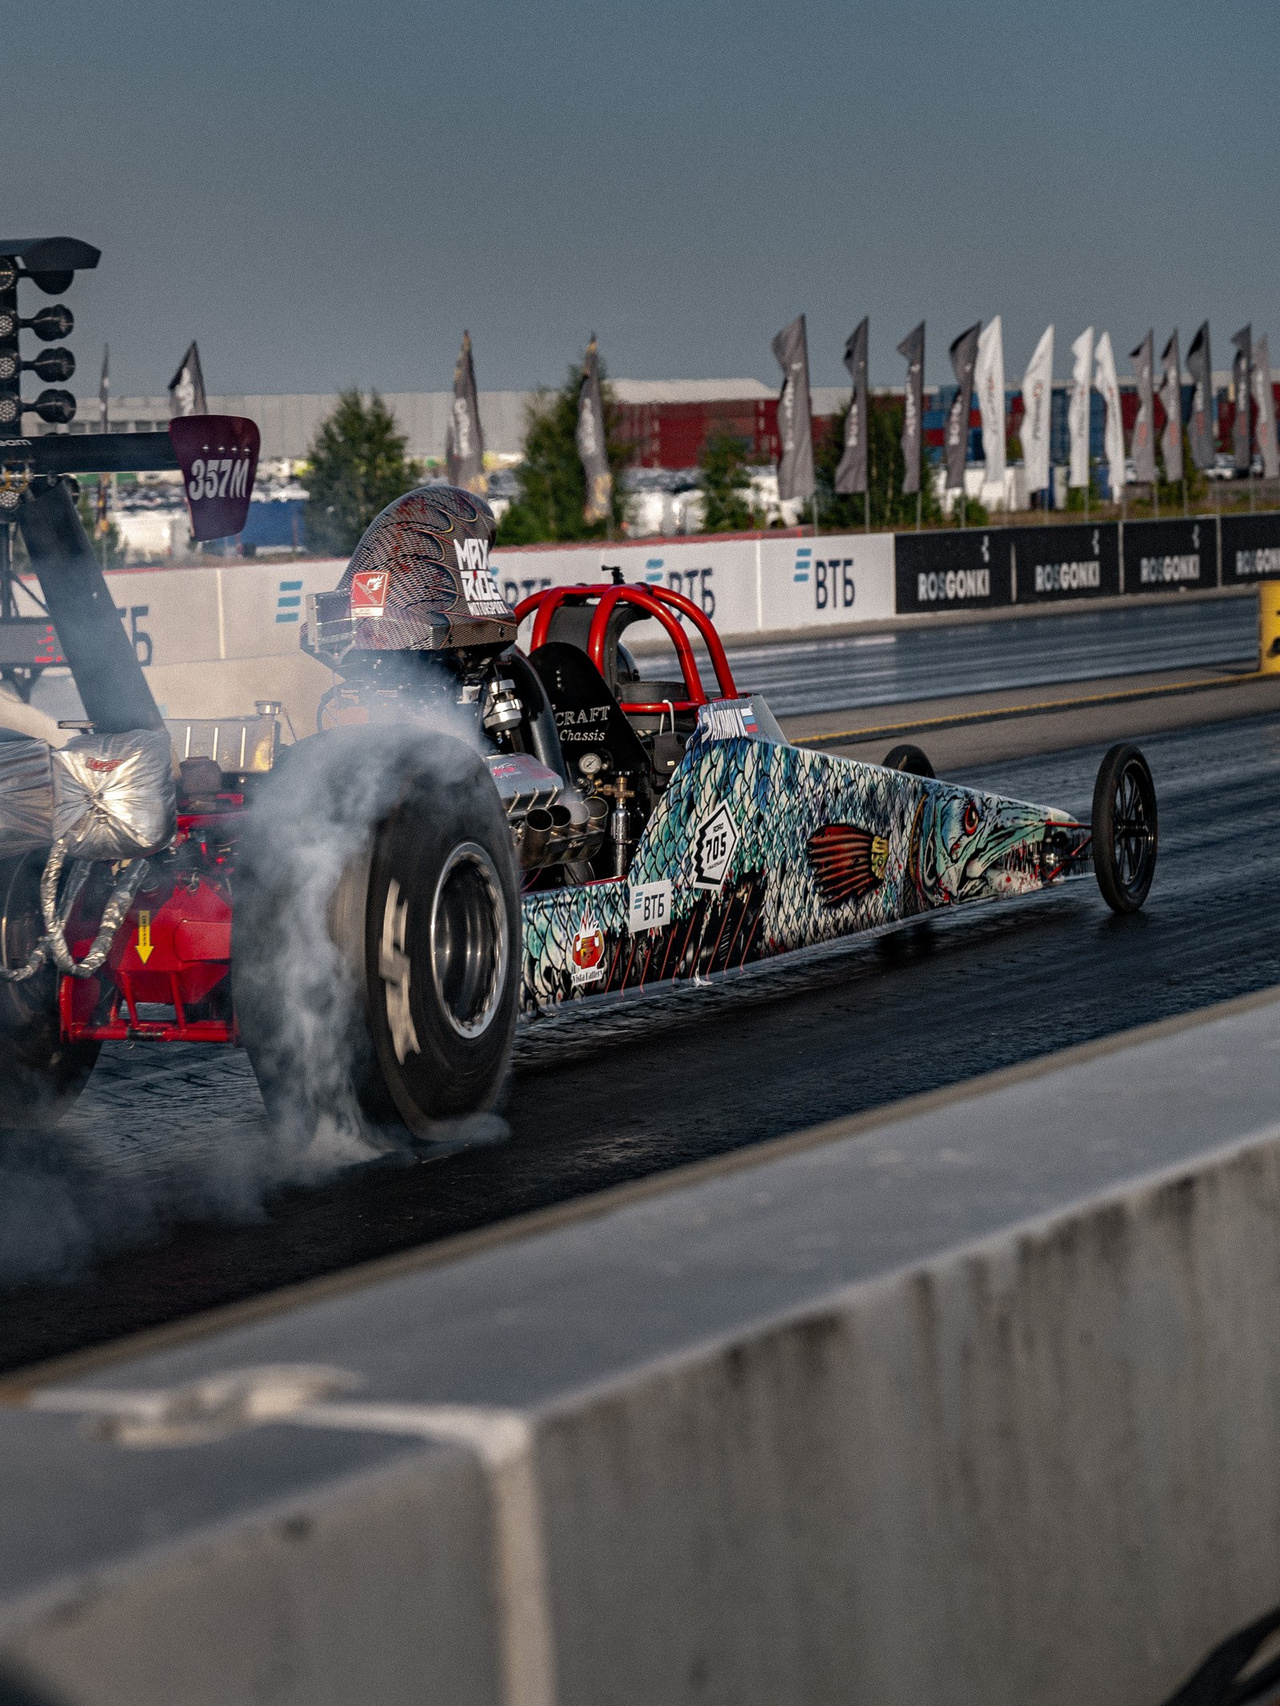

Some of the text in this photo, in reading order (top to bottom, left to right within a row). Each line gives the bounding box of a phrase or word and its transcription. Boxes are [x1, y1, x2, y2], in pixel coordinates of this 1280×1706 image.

[188, 458, 250, 500] 357M
[815, 558, 856, 610] ВТБ
[1035, 561, 1100, 592] ROSGONKI
[1140, 554, 1200, 583] ROSGONKI
[917, 569, 990, 601] ROSGONKI
[559, 729, 606, 741] Chassis
[705, 831, 727, 864] 705
[643, 892, 665, 922] ВТБ
